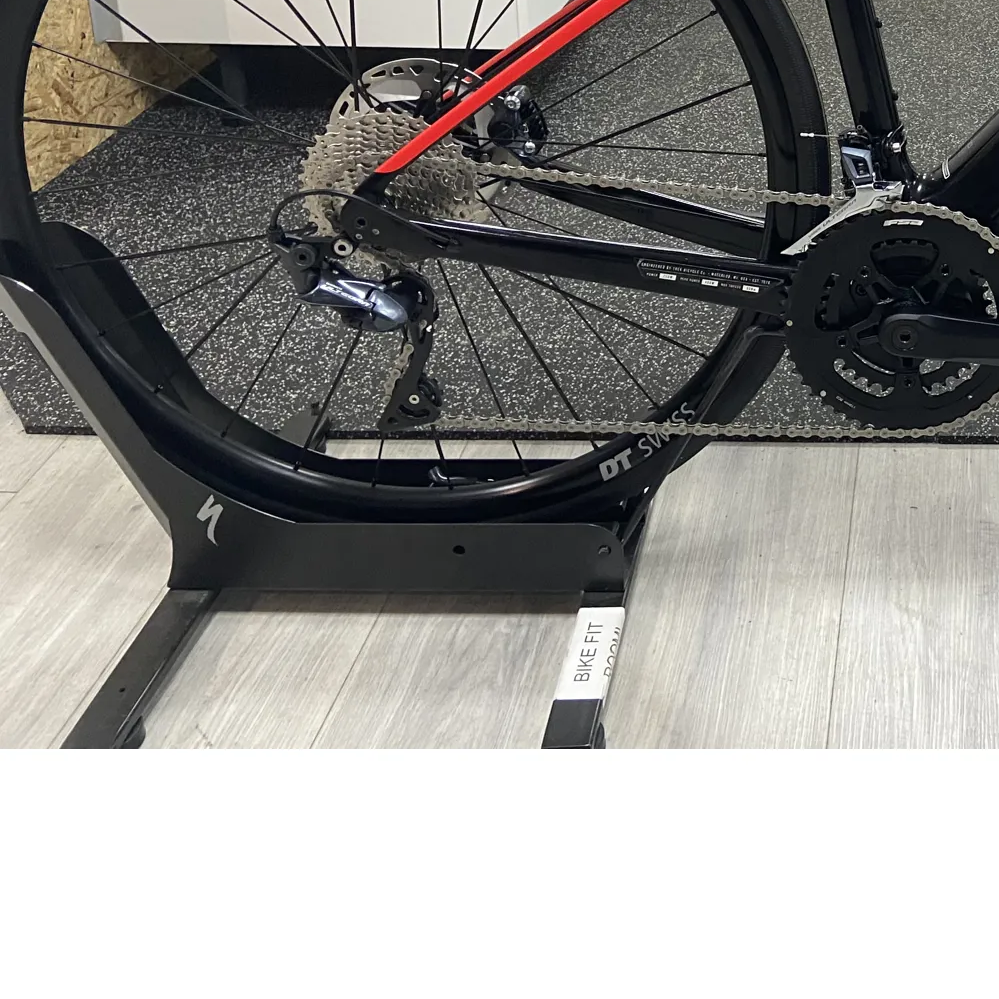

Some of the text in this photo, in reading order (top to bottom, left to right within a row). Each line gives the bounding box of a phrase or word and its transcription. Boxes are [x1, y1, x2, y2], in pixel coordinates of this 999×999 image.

[599, 402, 695, 482] DT SWSS
[573, 621, 604, 682] BIKE FIT
